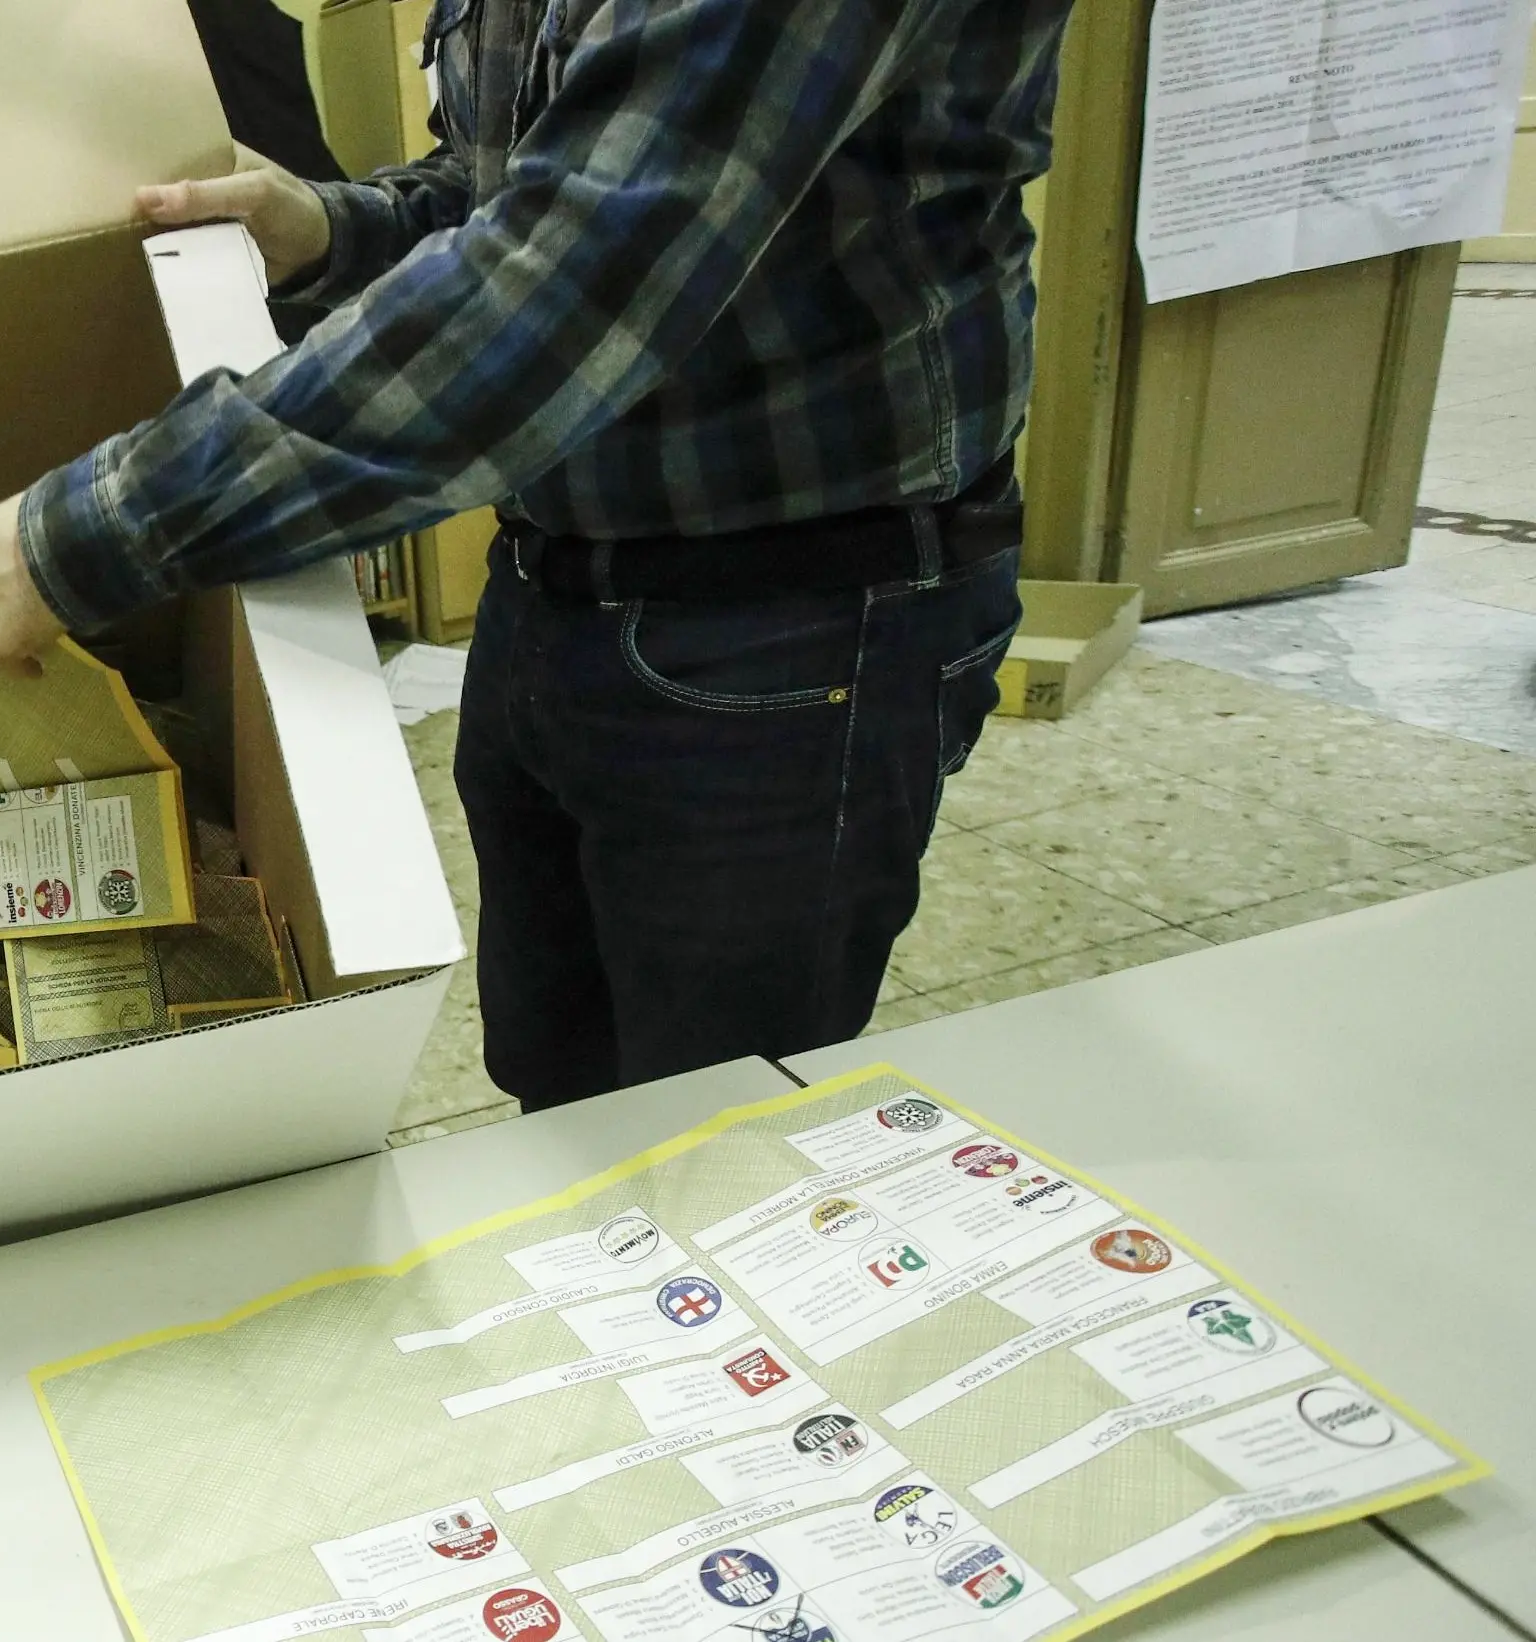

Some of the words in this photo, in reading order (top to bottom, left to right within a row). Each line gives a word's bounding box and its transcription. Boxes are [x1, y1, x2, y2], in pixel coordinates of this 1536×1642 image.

[71, 822, 86, 876] VINCENZINA
[7, 882, 18, 923] insieme
[859, 1146, 925, 1176] VINCENZINA
[797, 1168, 860, 1197] DONATELLA
[1011, 1179, 1073, 1210] insieme
[747, 1195, 798, 1223] MORELLI
[818, 1210, 871, 1237] EUROPA
[608, 1227, 656, 1258] MOVIMENTO
[970, 1259, 1008, 1284] EMMA
[548, 1283, 599, 1306] CLAUDIO
[922, 1278, 971, 1309] BONINO
[490, 1297, 548, 1323] CONSOLO
[1069, 1294, 1149, 1329] FRANCESCA
[1027, 1324, 1070, 1350] MARIA
[615, 1352, 649, 1369] LUIGI
[990, 1345, 1029, 1370] ANNA
[558, 1361, 615, 1384] INTORCIA
[955, 1363, 993, 1390] RAGA
[1145, 1392, 1215, 1424] GIUSEPPE
[655, 1426, 714, 1454] ALFONSO
[799, 1418, 844, 1450] ITALIA
[614, 1447, 654, 1467] GALDI
[737, 1498, 795, 1524] ALESSIA
[873, 1485, 925, 1521] SALVINI
[675, 1514, 737, 1547] AUGELLO
[903, 1509, 954, 1547] LEGA
[290, 1606, 365, 1633] CAPORALE
[366, 1597, 408, 1622] IRENE
